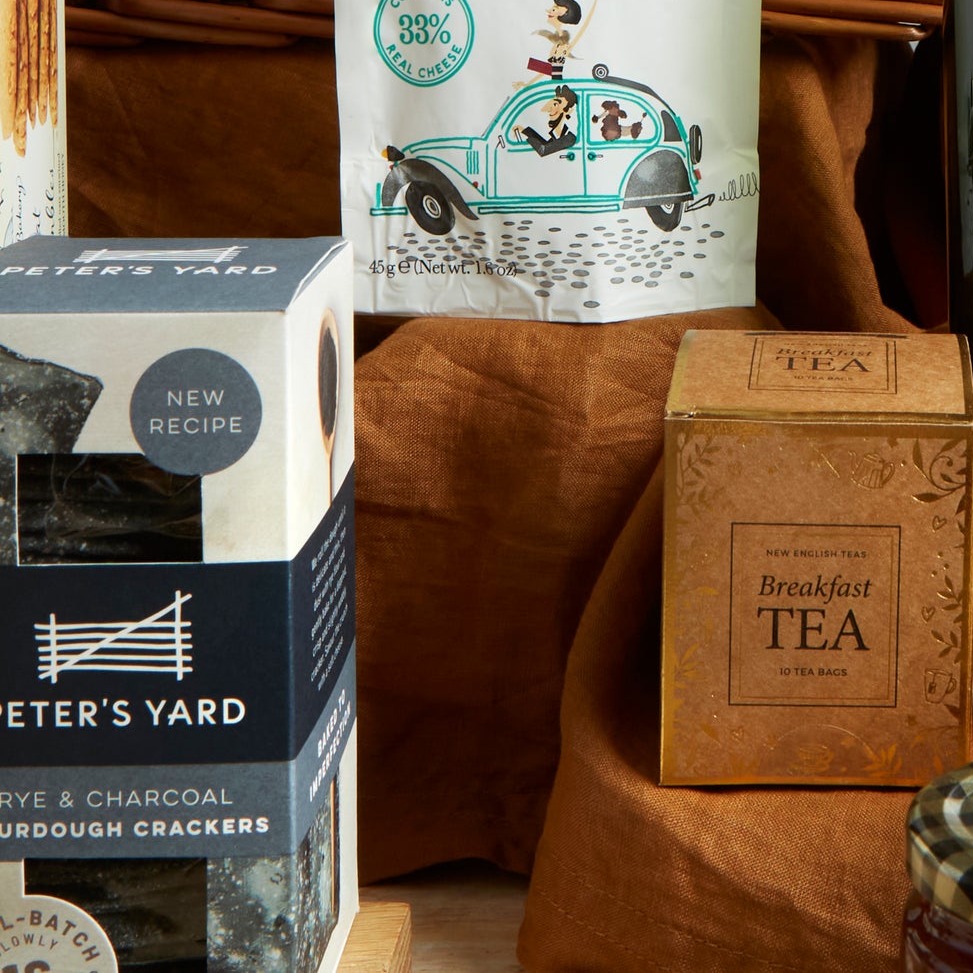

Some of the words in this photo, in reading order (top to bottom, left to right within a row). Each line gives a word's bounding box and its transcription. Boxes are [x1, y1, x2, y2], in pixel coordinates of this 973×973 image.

[398, 13, 451, 45] 33%
[386, 44, 412, 75] REAL
[418, 44, 462, 78] CHEESE
[0, 266, 154, 277] PETER'S
[174, 266, 278, 275] YARD
[414, 259, 445, 275] (Net
[449, 263, 470, 275] wt.
[776, 348, 872, 357] Breakfast
[776, 356, 872, 372] TEA
[168, 390, 225, 406] NEW
[150, 417, 243, 434] RECIPE
[766, 549, 790, 558] NEW
[794, 549, 837, 558] ENGLISH
[841, 550, 867, 559] TEAS
[758, 574, 872, 603] Breakfast
[757, 607, 870, 651] TEA
[779, 668, 790, 677] 10
[794, 668, 815, 677] TEA
[818, 668, 848, 677] BAGS
[0, 698, 131, 728] ETER'S
[145, 698, 246, 726] YARD
[318, 708, 337, 758] BAKED
[338, 689, 345, 712] TO
[0, 791, 46, 808] RYE
[59, 791, 74, 808] &
[87, 788, 233, 807] CHARCOAL
[133, 817, 270, 837] CRACKERS
[0, 933, 58, 956] LOWLY
